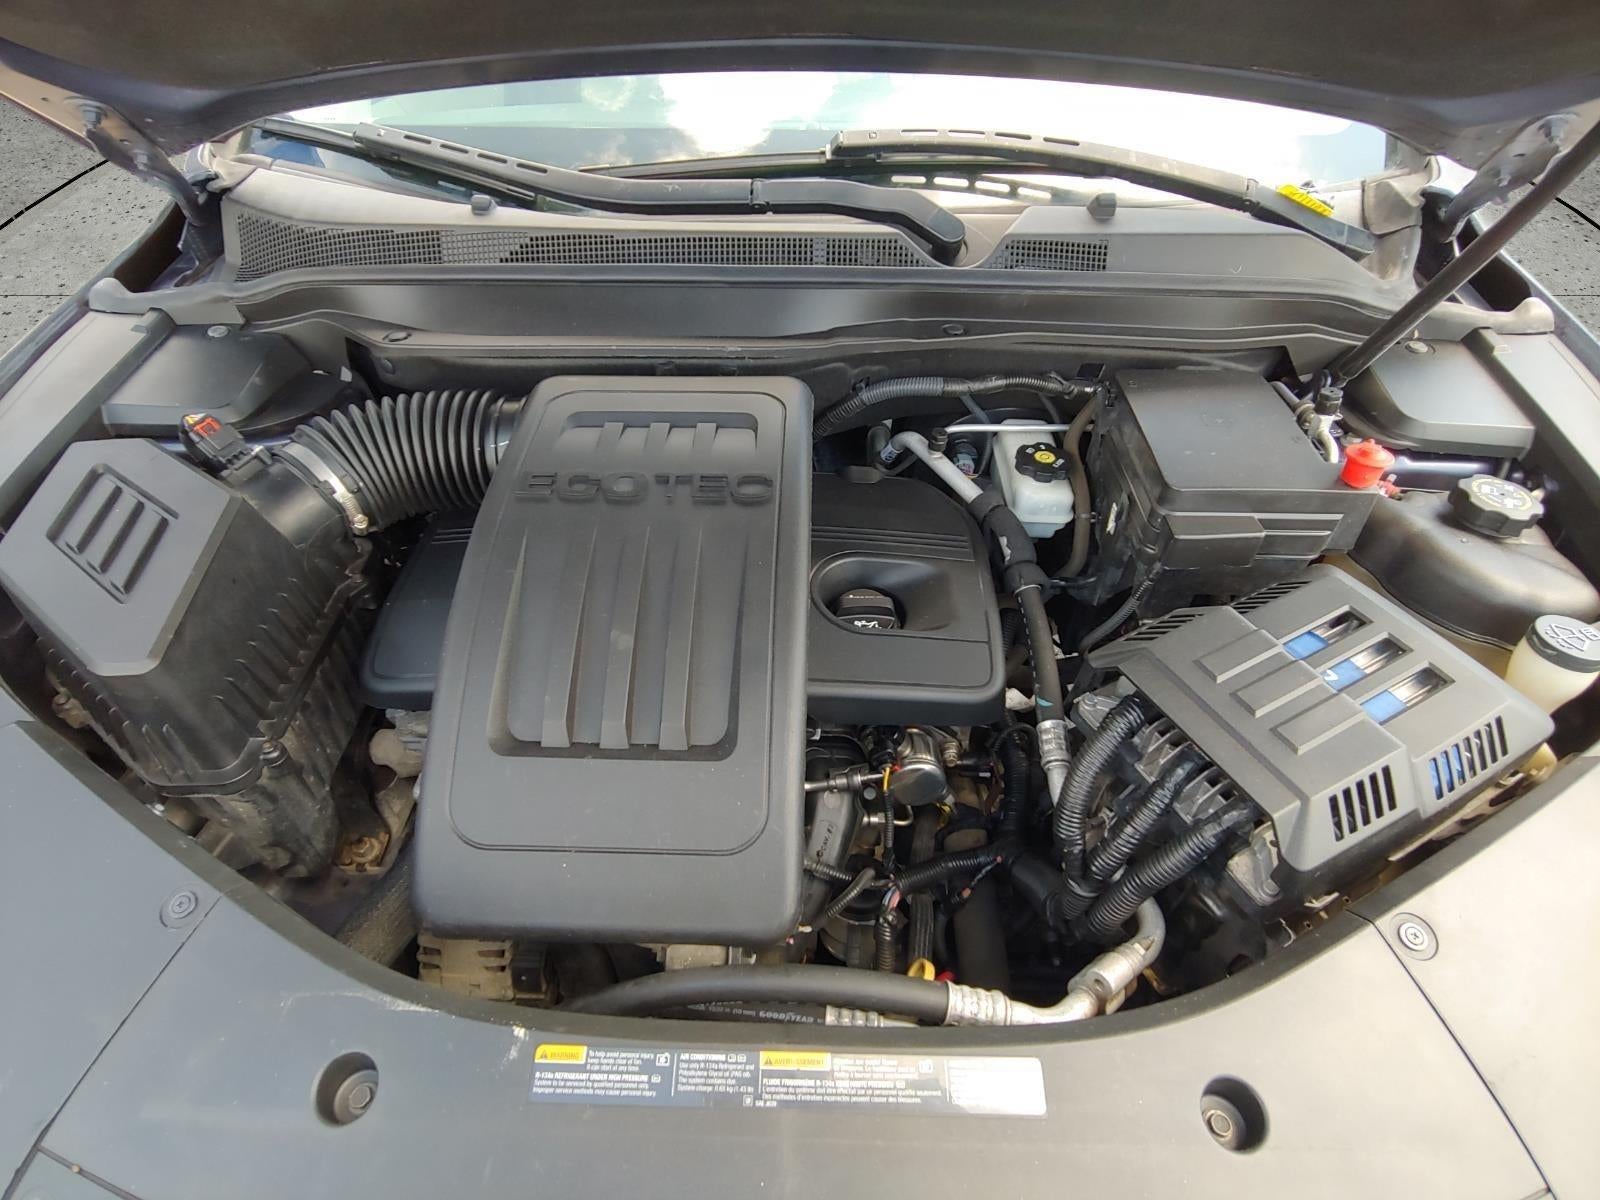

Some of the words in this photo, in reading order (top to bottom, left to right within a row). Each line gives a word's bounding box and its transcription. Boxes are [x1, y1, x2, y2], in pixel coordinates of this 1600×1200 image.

[513, 471, 774, 507] ECOTEC
[759, 1010, 814, 1023] GOODYEAR
[550, 1051, 580, 1060] WARNING
[680, 1053, 690, 1061] AIR
[690, 1053, 726, 1061] CONDITIONING
[554, 1072, 589, 1080] REFRIGERANT
[589, 1073, 608, 1081] UNDER
